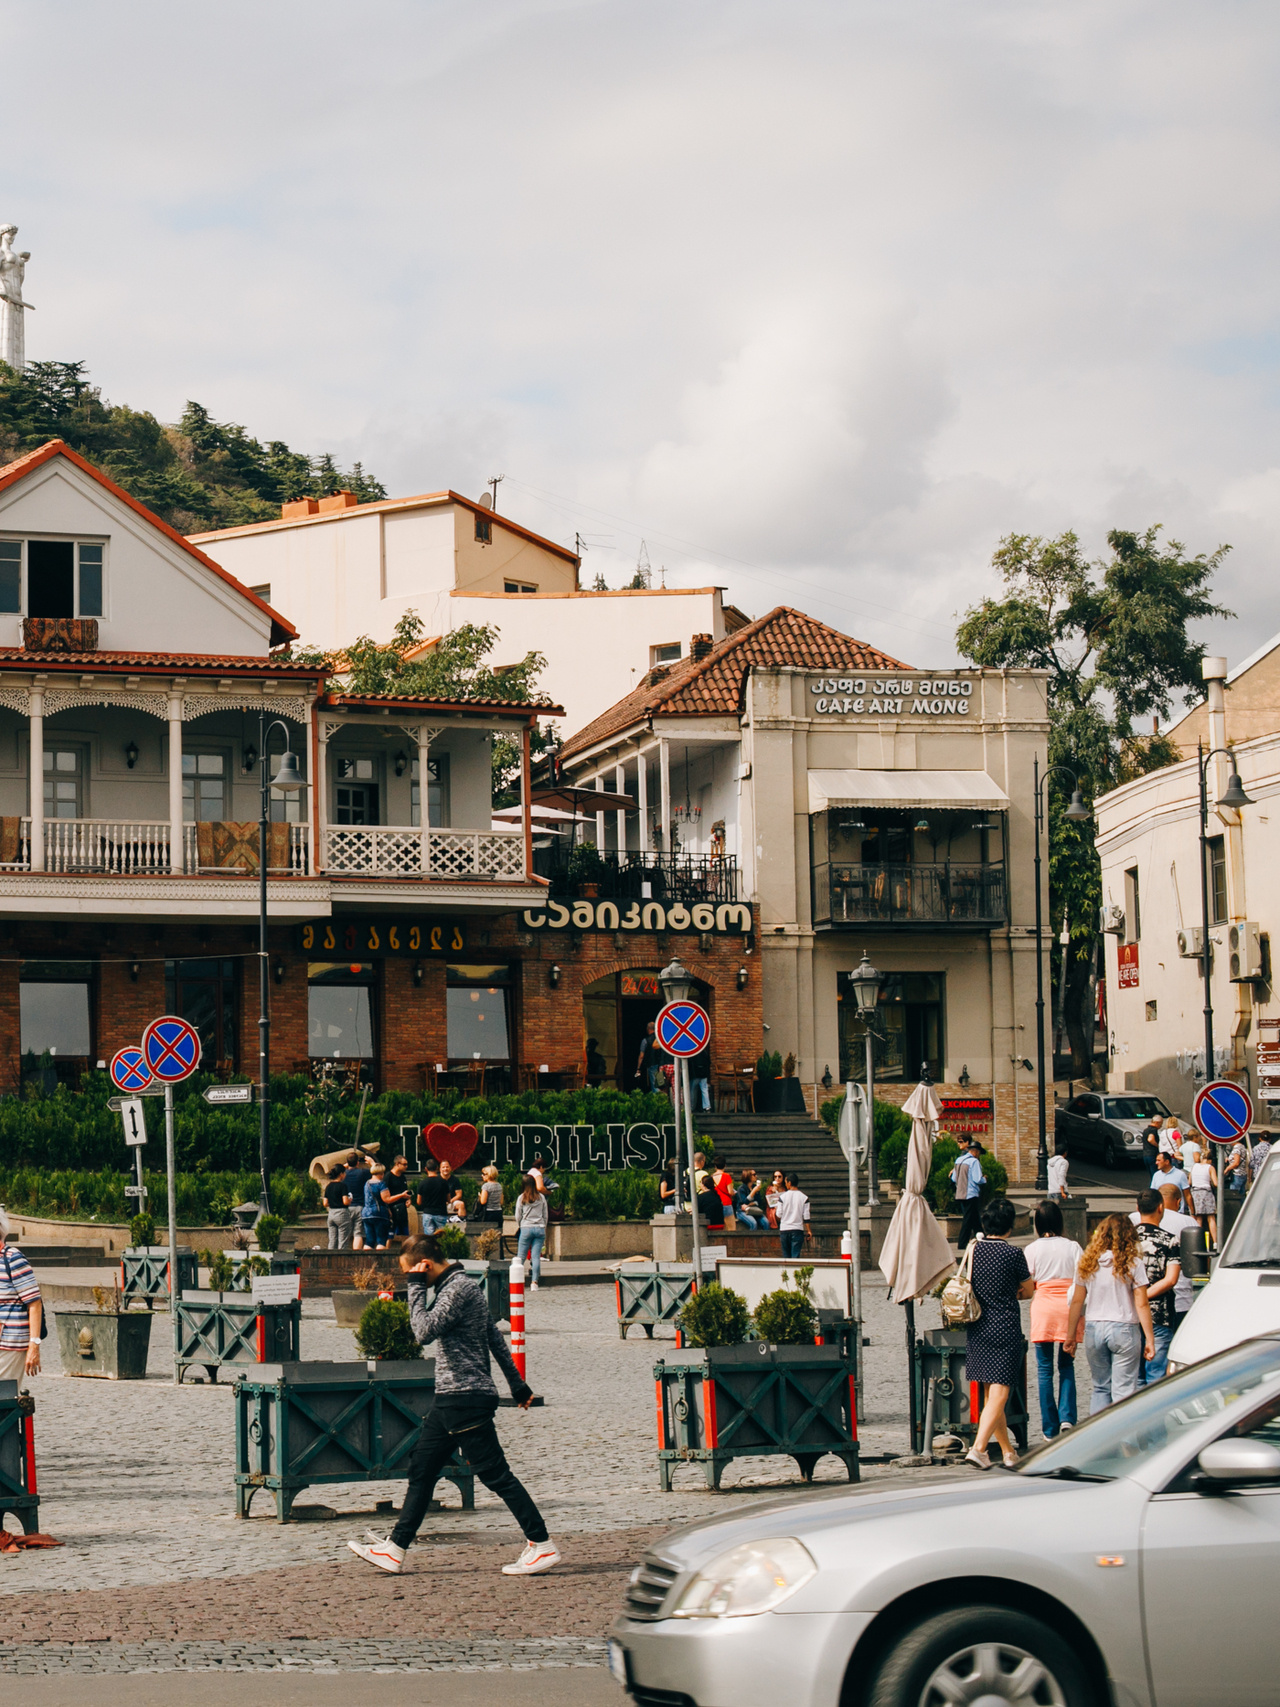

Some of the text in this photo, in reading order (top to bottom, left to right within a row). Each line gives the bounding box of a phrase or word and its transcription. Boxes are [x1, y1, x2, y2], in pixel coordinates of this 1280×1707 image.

[811, 678, 867, 695] კაფე
[815, 697, 970, 715] CAFE ART MONE
[523, 901, 751, 932] სამიკიტნო
[621, 976, 658, 994] 24/24
[942, 1100, 990, 1109] EXCHANGE
[400, 1122, 676, 1172] I TBILISI
